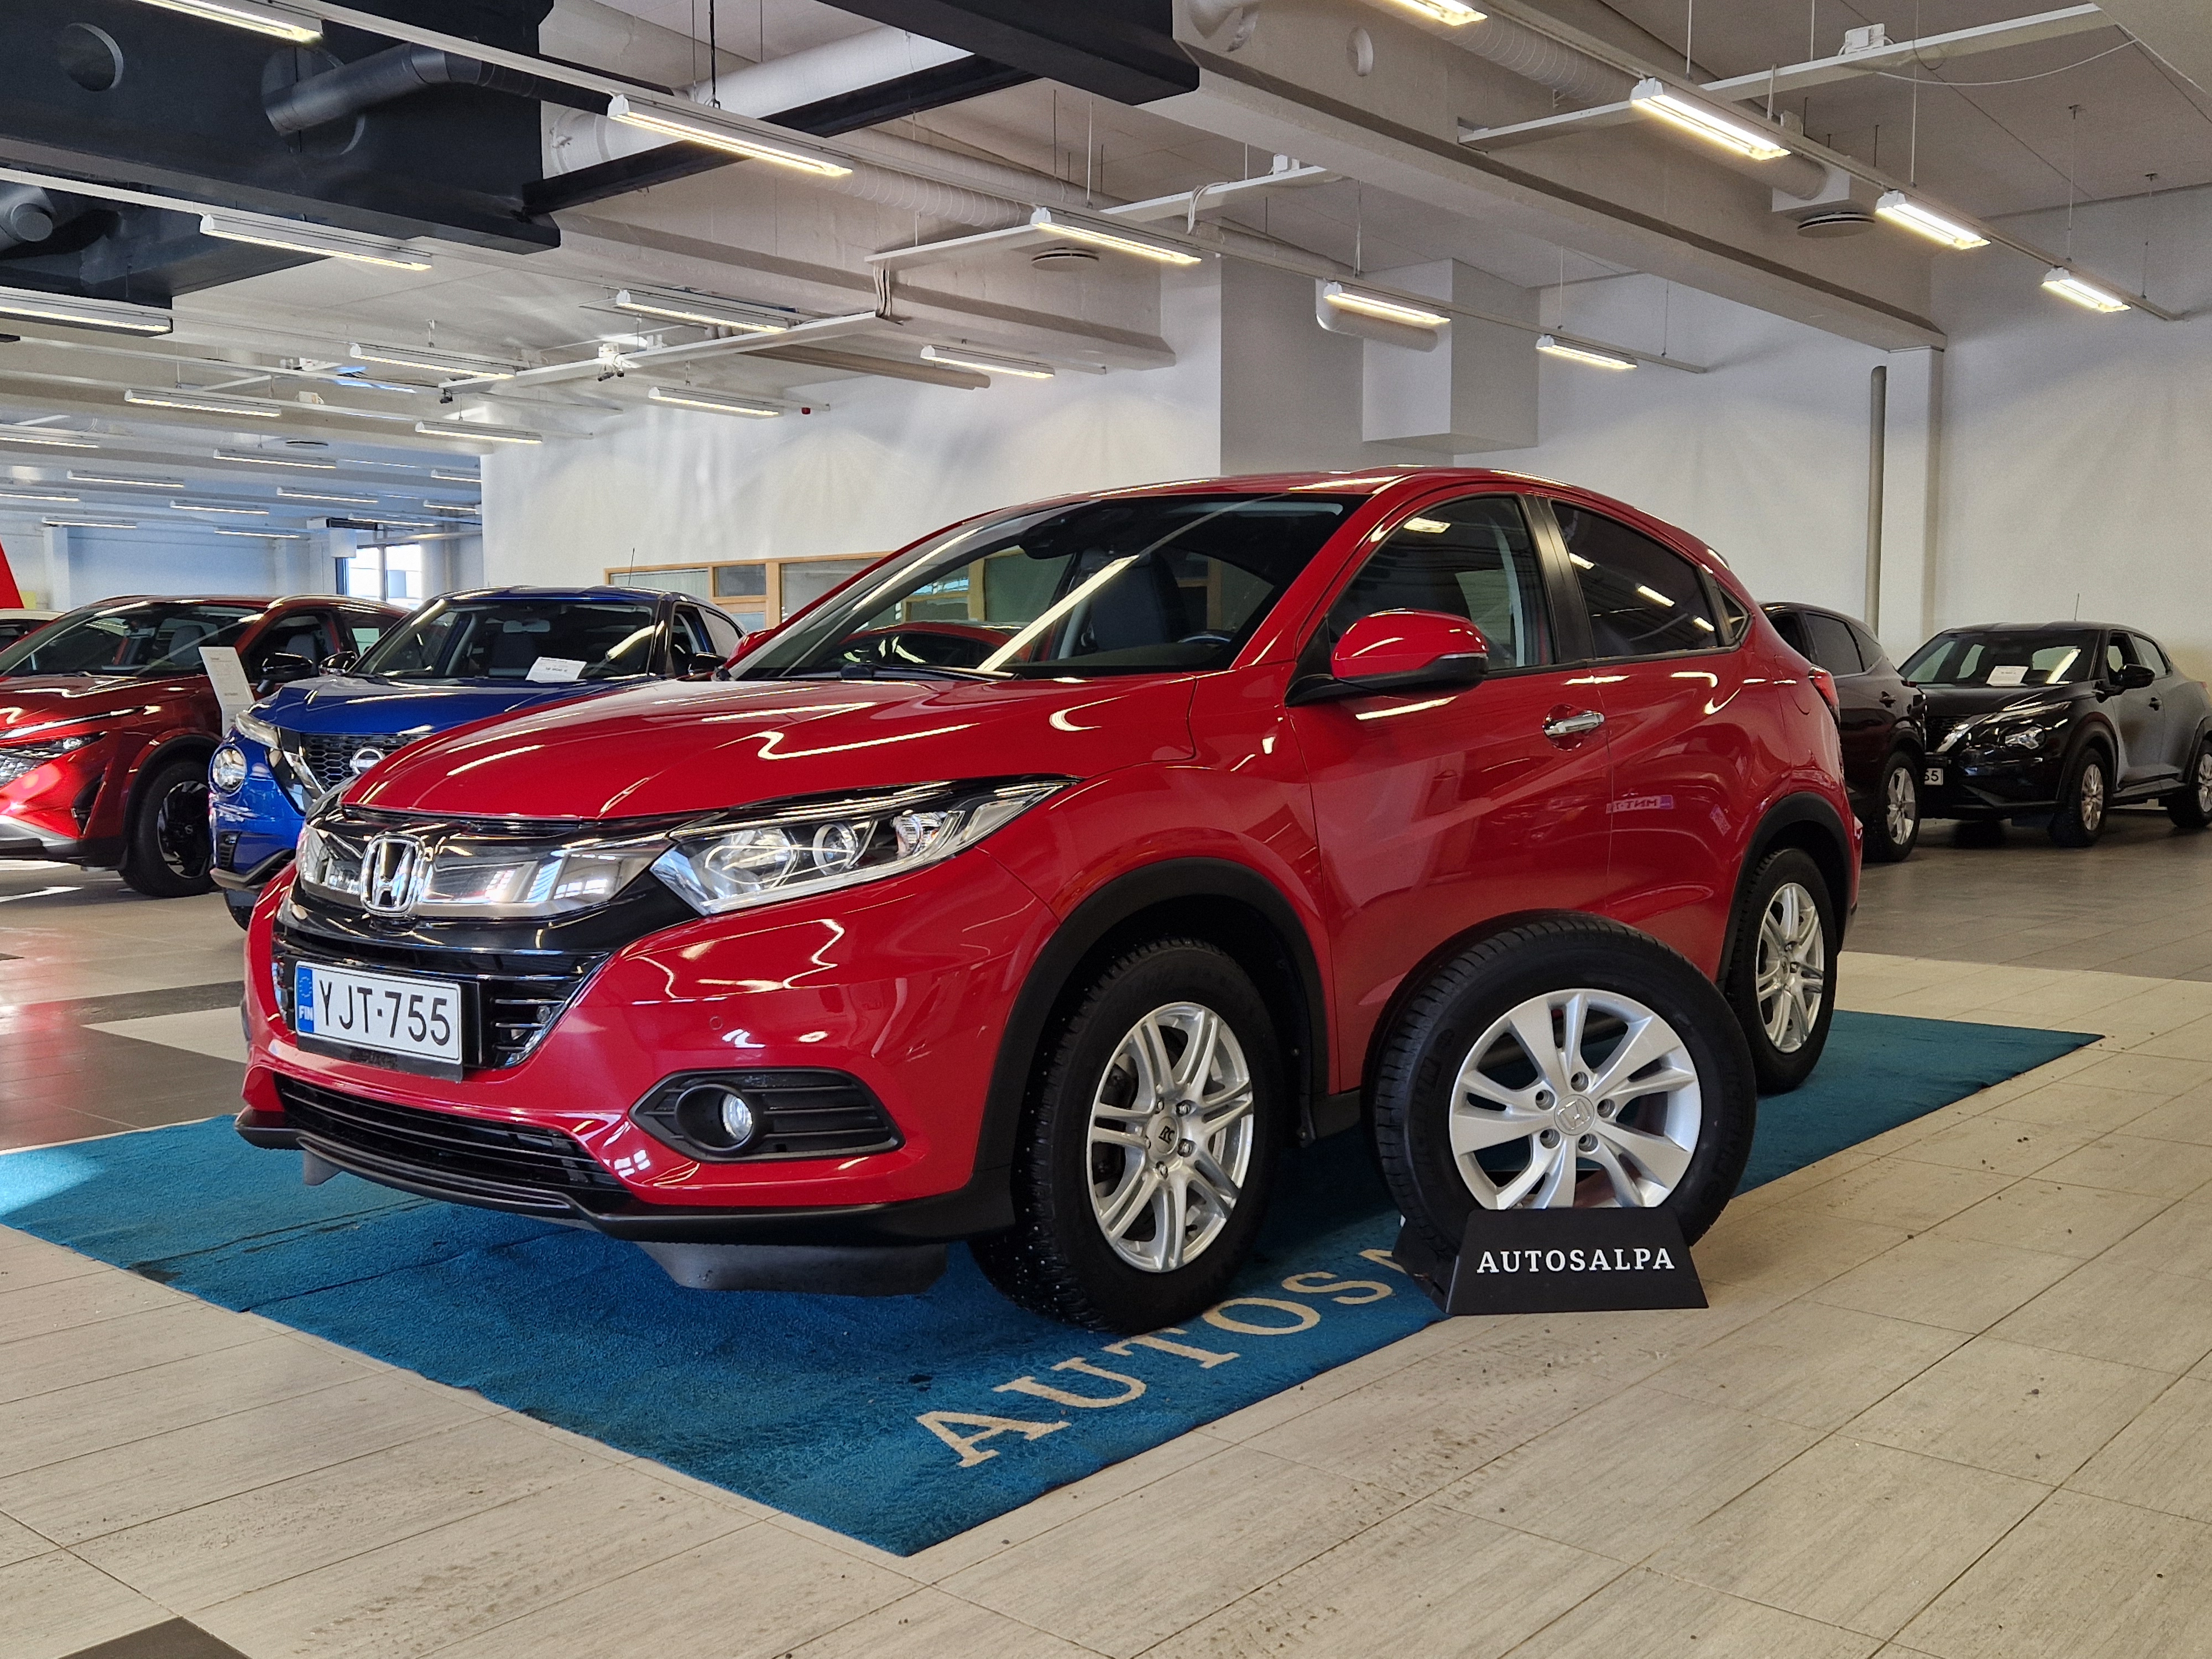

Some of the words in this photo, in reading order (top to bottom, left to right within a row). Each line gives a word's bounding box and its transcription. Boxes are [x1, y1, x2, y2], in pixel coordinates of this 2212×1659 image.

[299, 1005, 314, 1021] FIN
[319, 979, 451, 1046] YJT-755
[1476, 1248, 1675, 1274] AUTOSALPA
